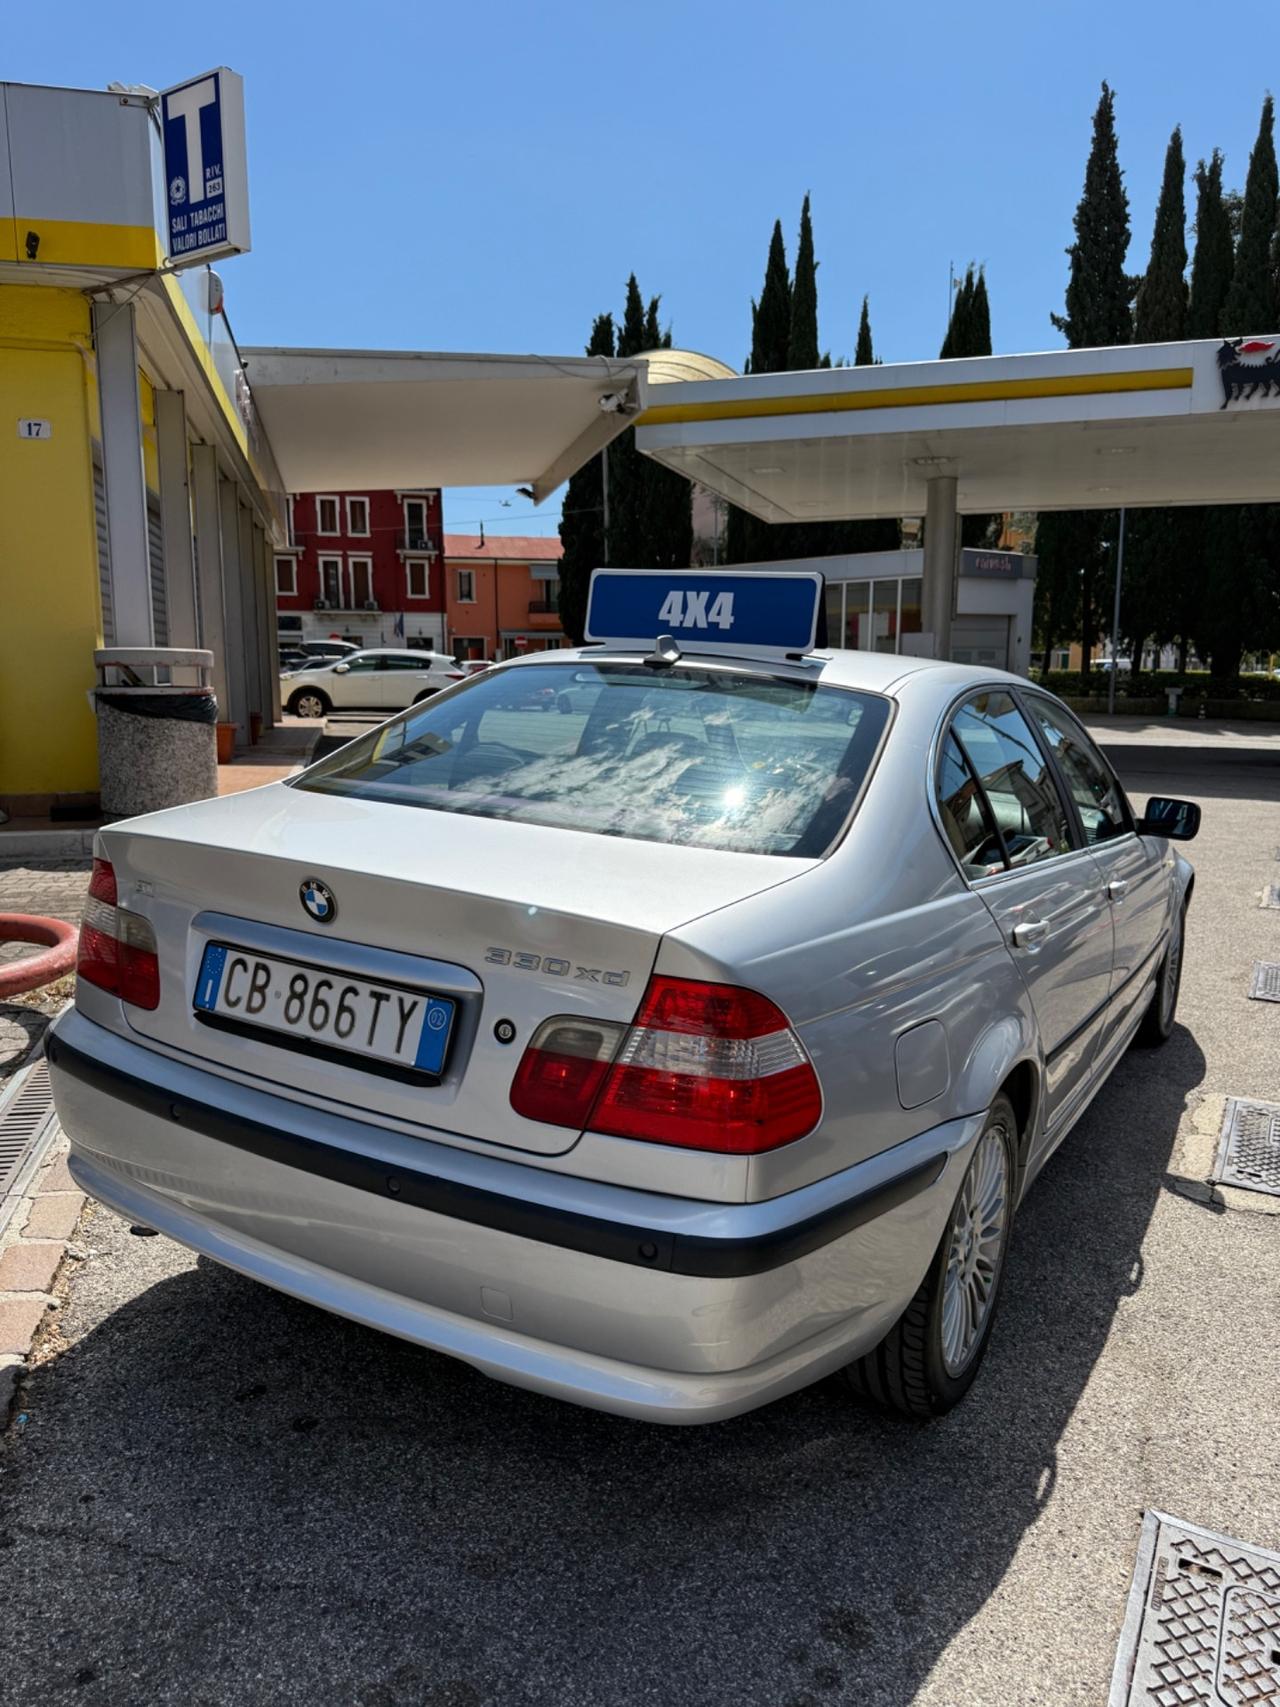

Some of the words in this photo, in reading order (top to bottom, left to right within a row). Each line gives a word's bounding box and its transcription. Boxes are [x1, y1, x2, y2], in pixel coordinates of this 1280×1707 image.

[167, 77, 216, 205] T
[171, 214, 188, 234] SALI
[190, 203, 223, 227] TABACCHI
[172, 232, 197, 253] VALORI
[198, 223, 225, 245] BOLLATI
[27, 422, 42, 436] 17
[658, 590, 734, 629] 4X4
